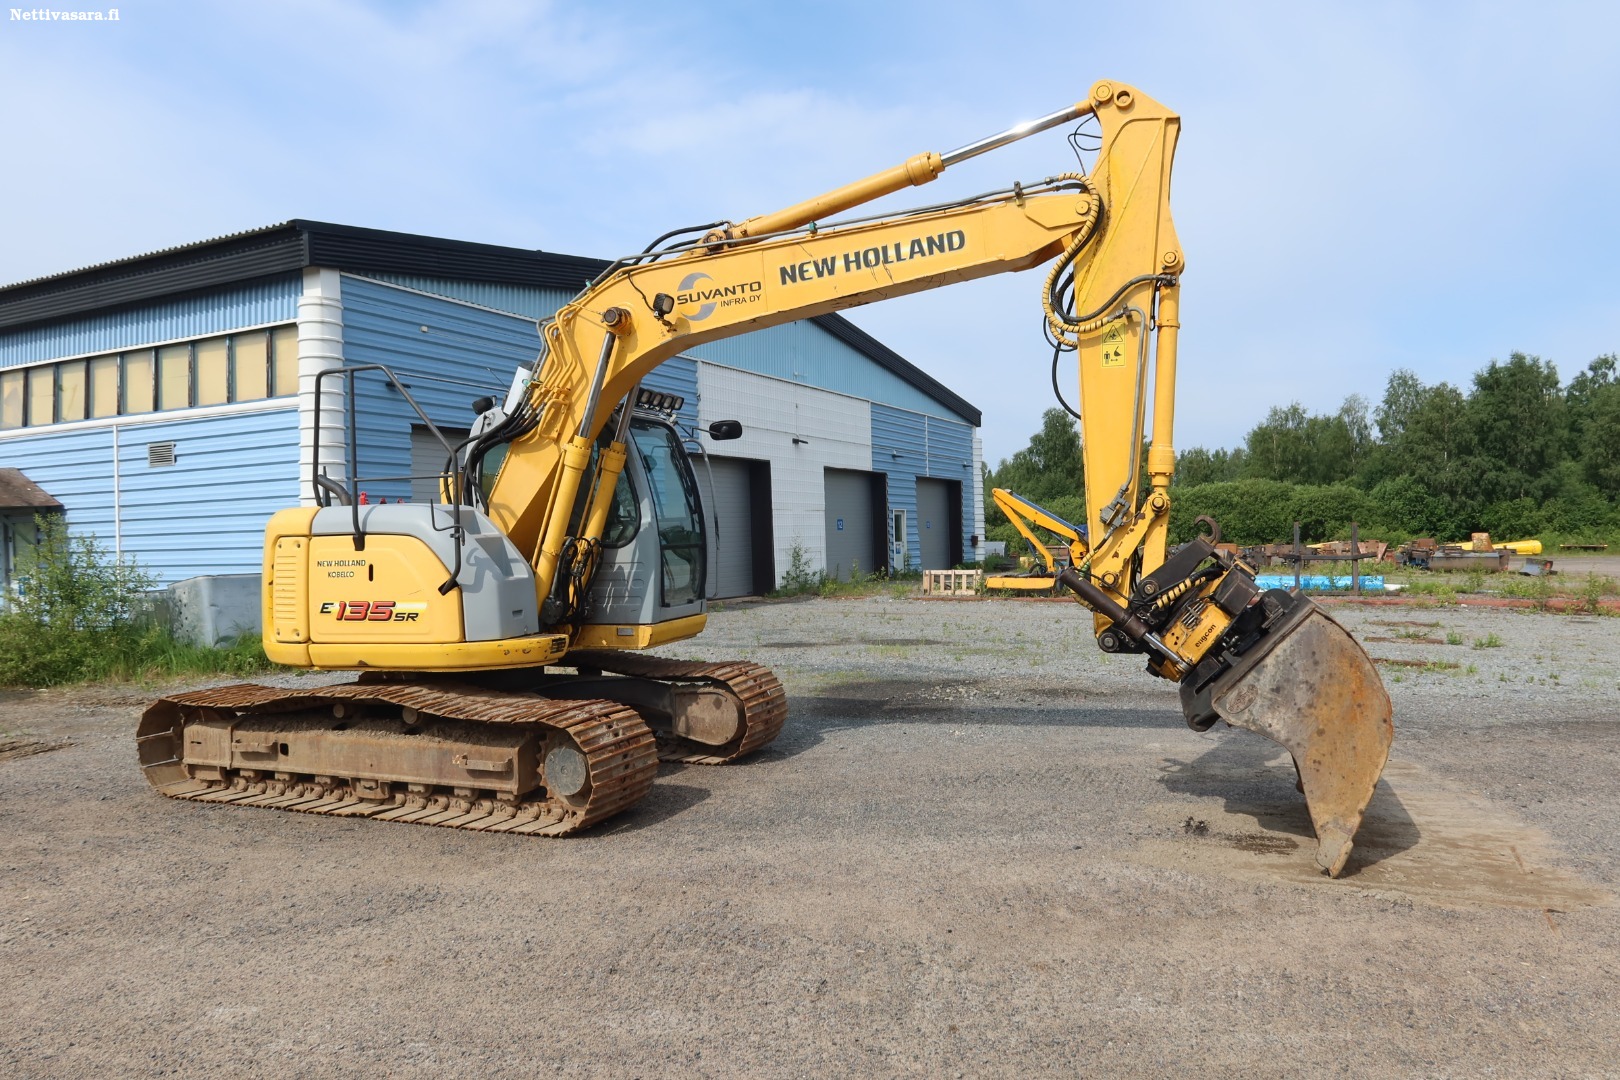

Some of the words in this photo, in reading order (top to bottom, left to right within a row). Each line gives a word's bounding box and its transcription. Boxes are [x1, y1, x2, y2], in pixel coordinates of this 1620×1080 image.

[779, 254, 836, 286] NEW
[843, 229, 966, 273] HOLLAND
[677, 281, 762, 305] SUVANTO
[720, 297, 747, 307] INFRA
[749, 293, 762, 303] OY
[334, 559, 366, 567] HOLLAND
